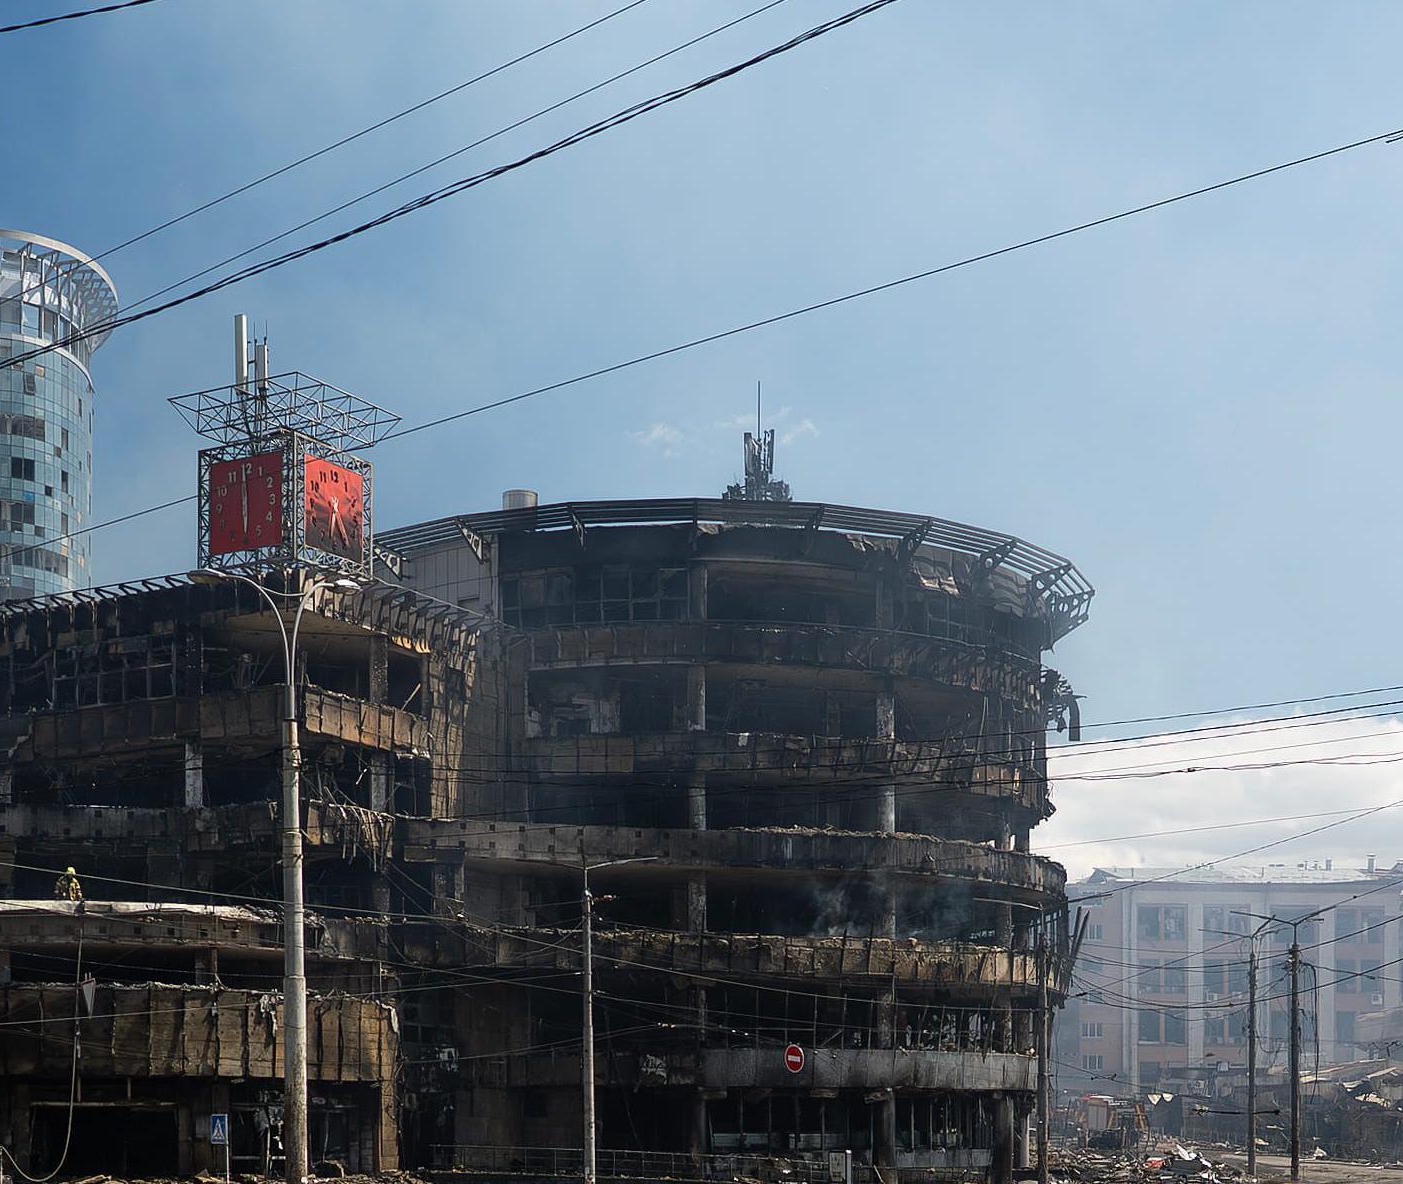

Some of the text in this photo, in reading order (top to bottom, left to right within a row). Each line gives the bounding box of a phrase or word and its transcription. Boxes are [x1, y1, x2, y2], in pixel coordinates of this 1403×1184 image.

[228, 471, 237, 483] 11
[267, 477, 273, 488] 2
[319, 470, 327, 484] 11
[330, 470, 339, 483] 12
[216, 485, 227, 497] 10
[310, 480, 319, 493] 10
[269, 494, 276, 505] 3
[266, 511, 273, 522] 4
